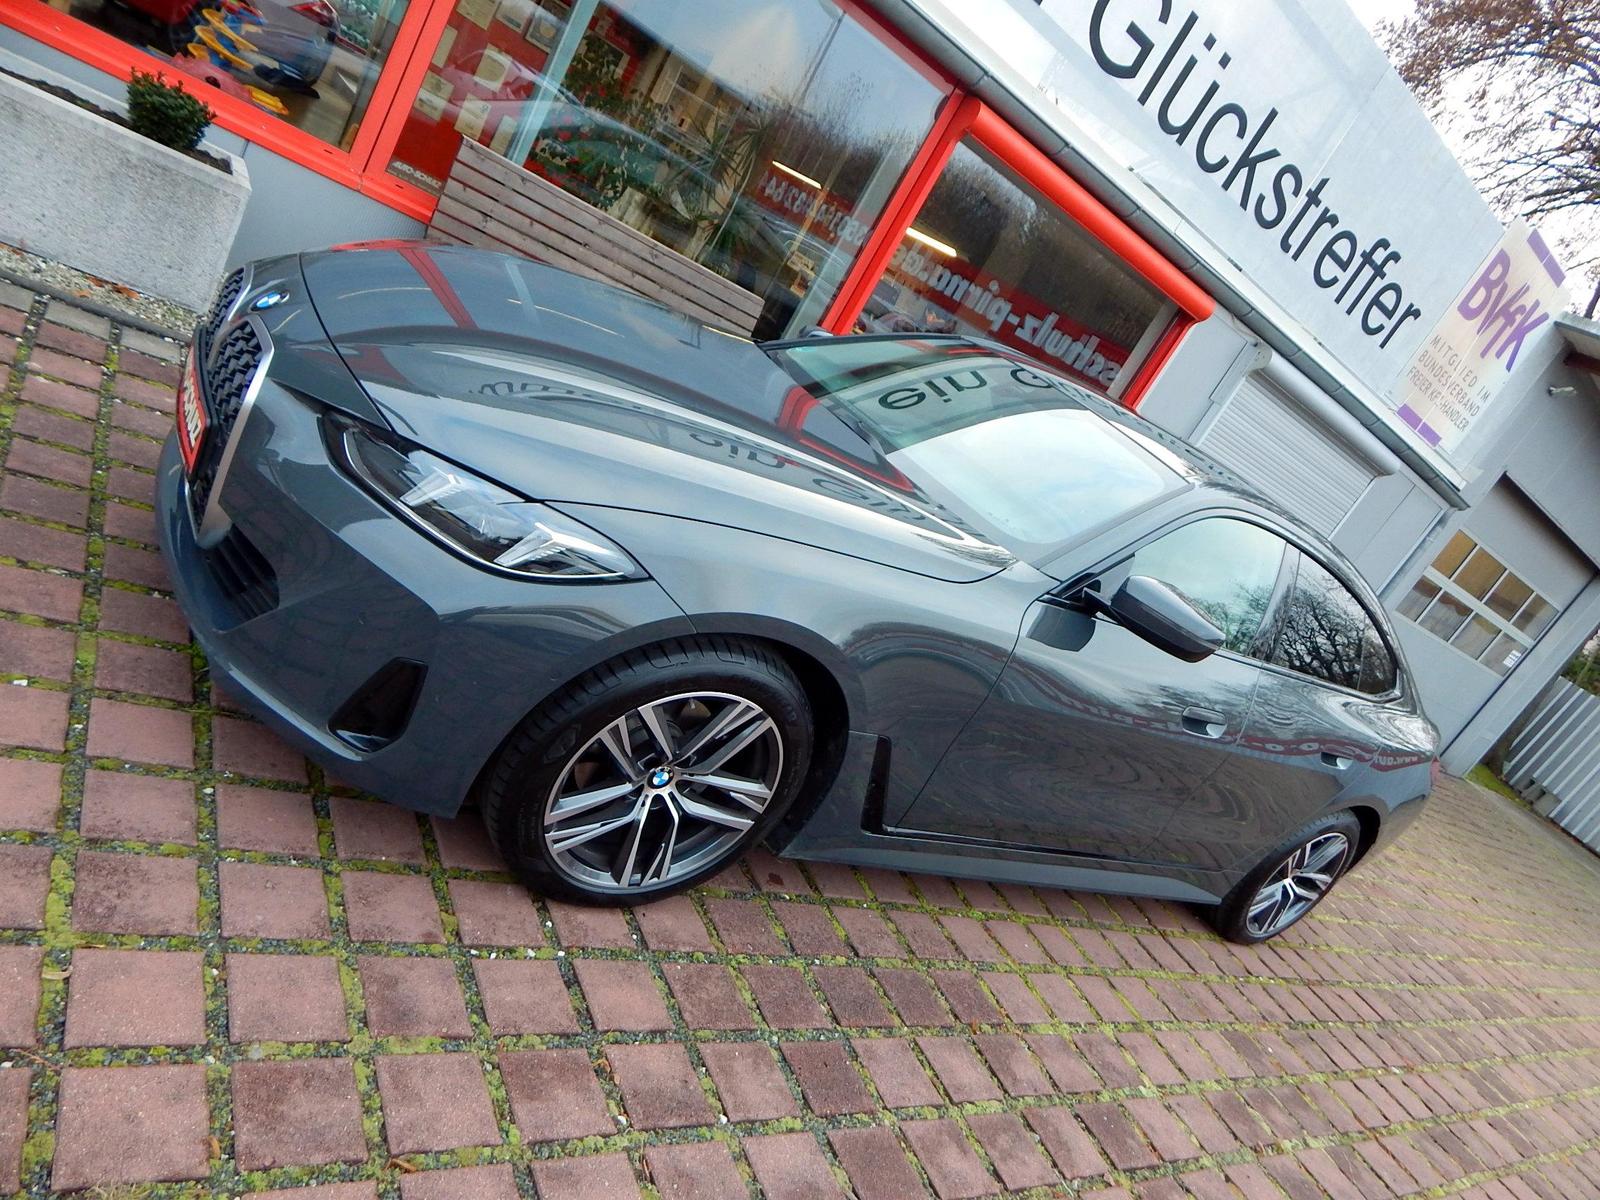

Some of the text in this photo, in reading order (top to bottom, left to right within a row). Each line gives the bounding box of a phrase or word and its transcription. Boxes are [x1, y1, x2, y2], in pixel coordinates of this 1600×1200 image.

[1089, 0, 1421, 349] Glückstreffer
[1418, 350, 1480, 417] BUNDESVERBAND
[1429, 334, 1491, 403] MITGLIED IM
